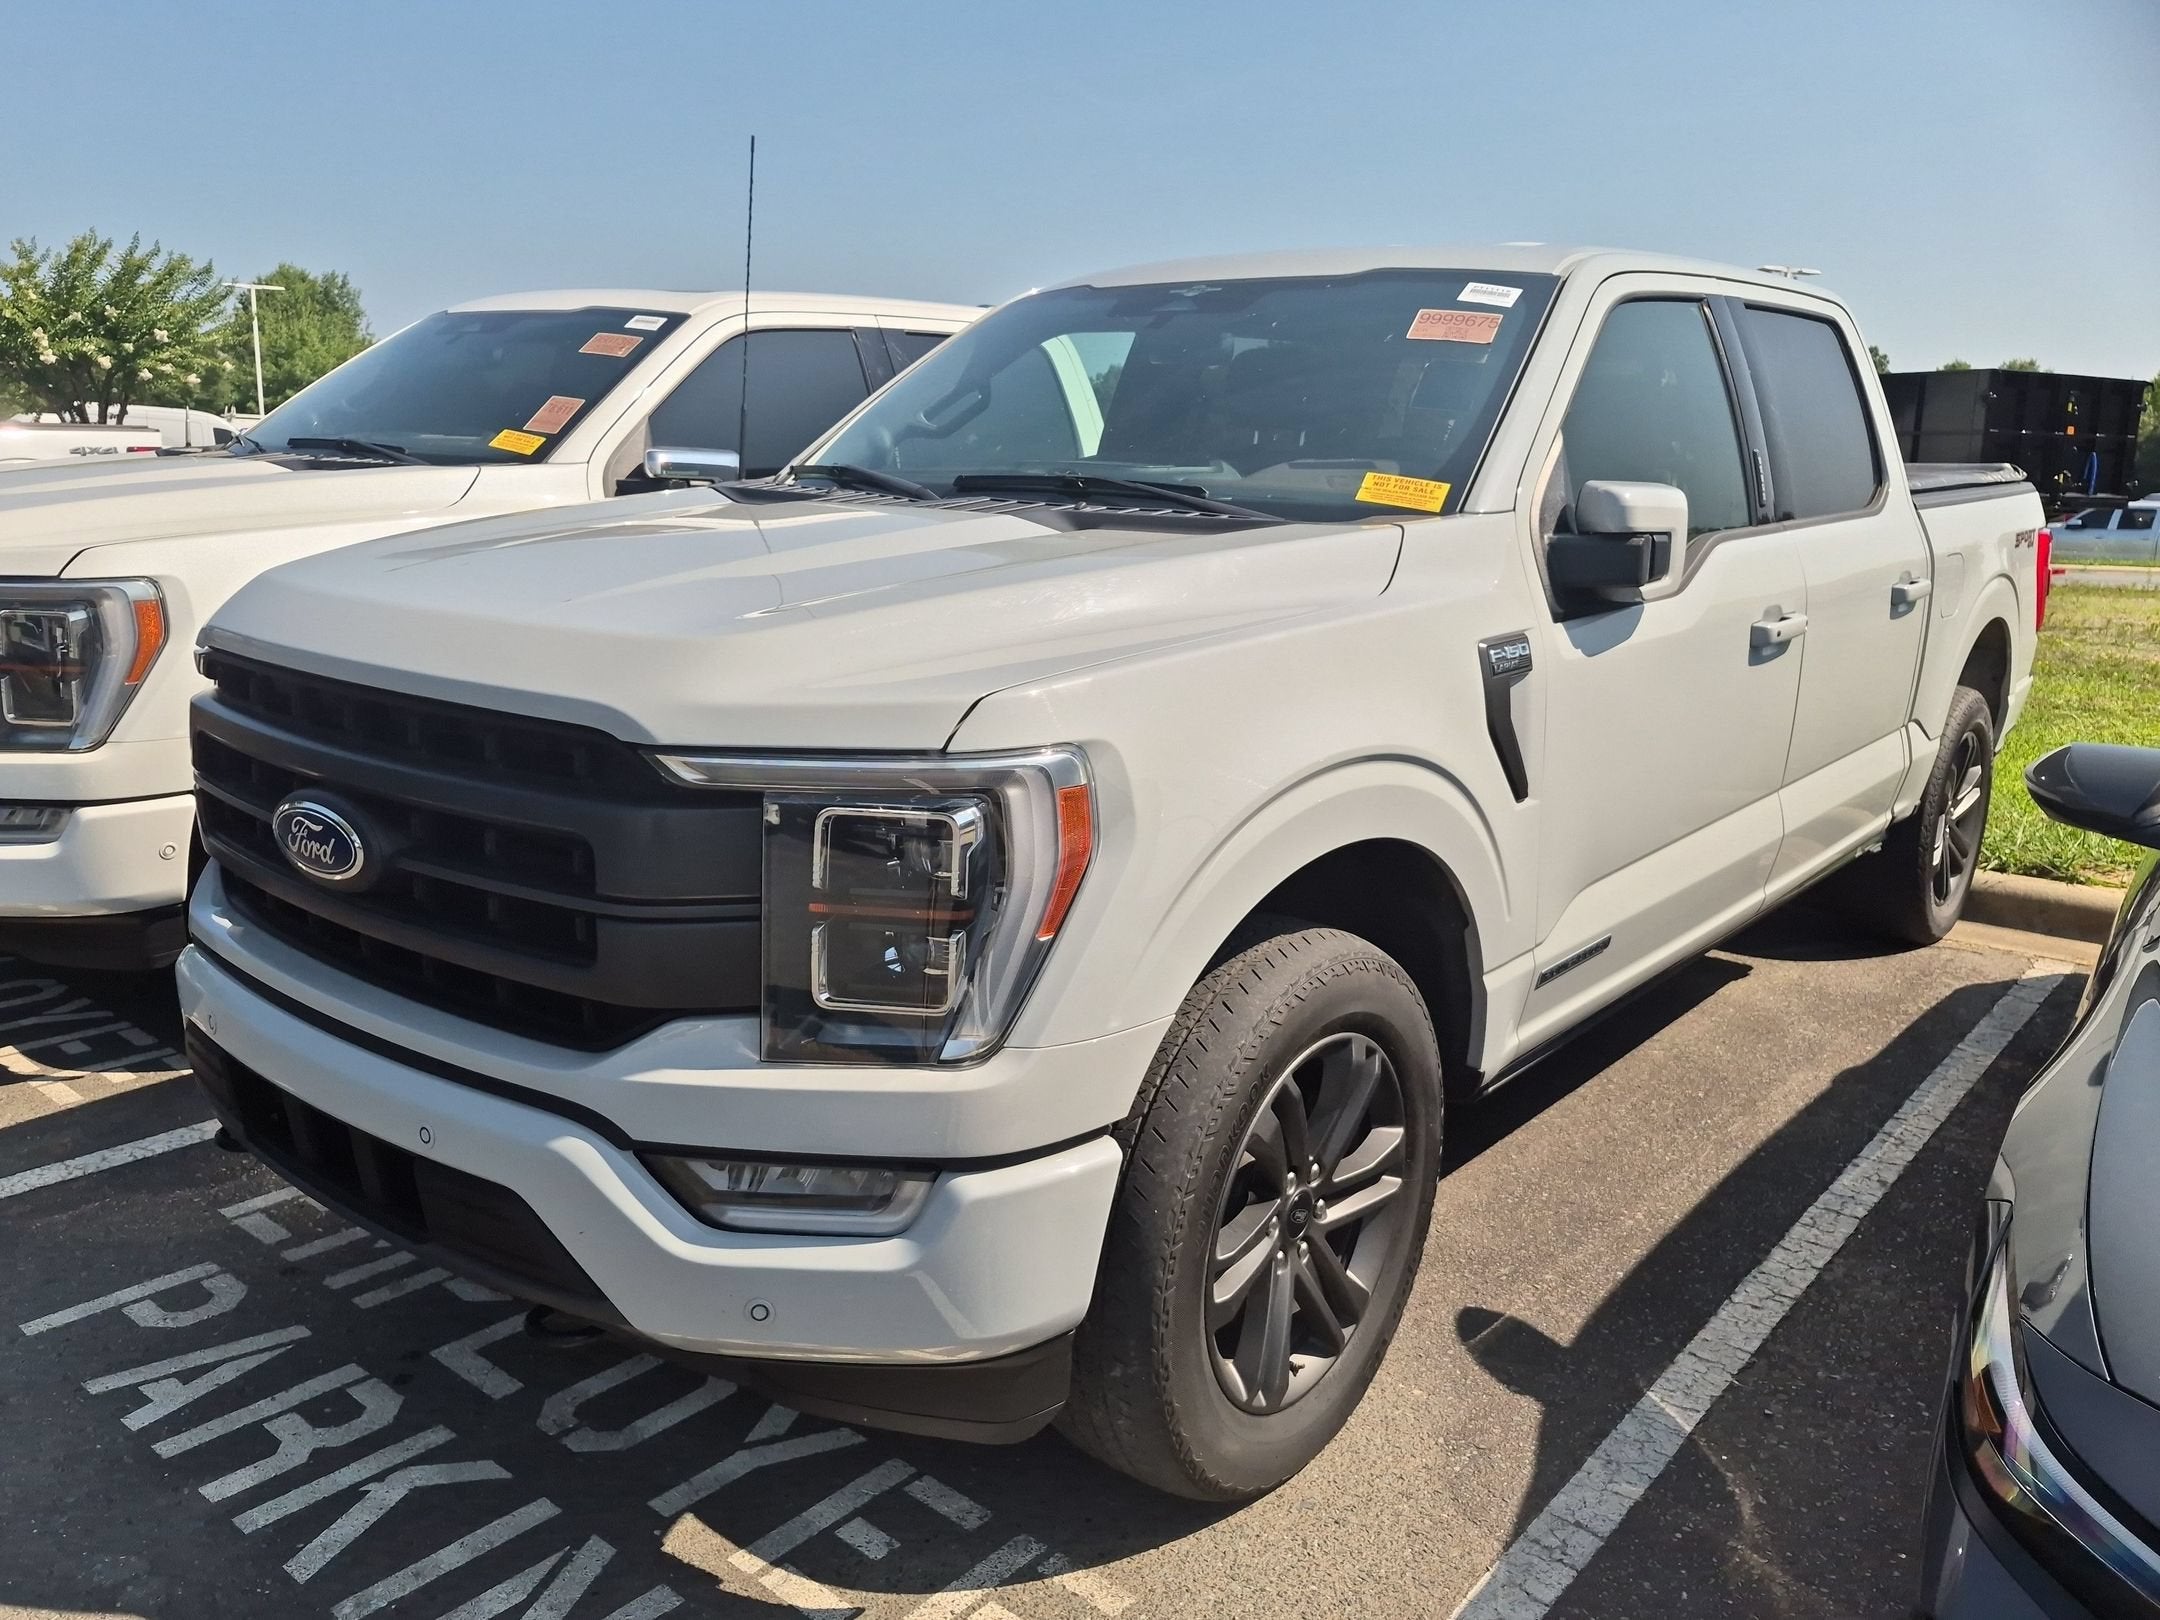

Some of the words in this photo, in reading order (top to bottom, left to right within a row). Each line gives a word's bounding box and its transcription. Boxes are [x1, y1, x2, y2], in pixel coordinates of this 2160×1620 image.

[1418, 313, 1499, 328] 9999675
[1394, 477, 1430, 488] VEHICLE
[1413, 486, 1435, 495] SALE
[1489, 643, 1530, 663] F-150
[288, 816, 336, 865] Ford
